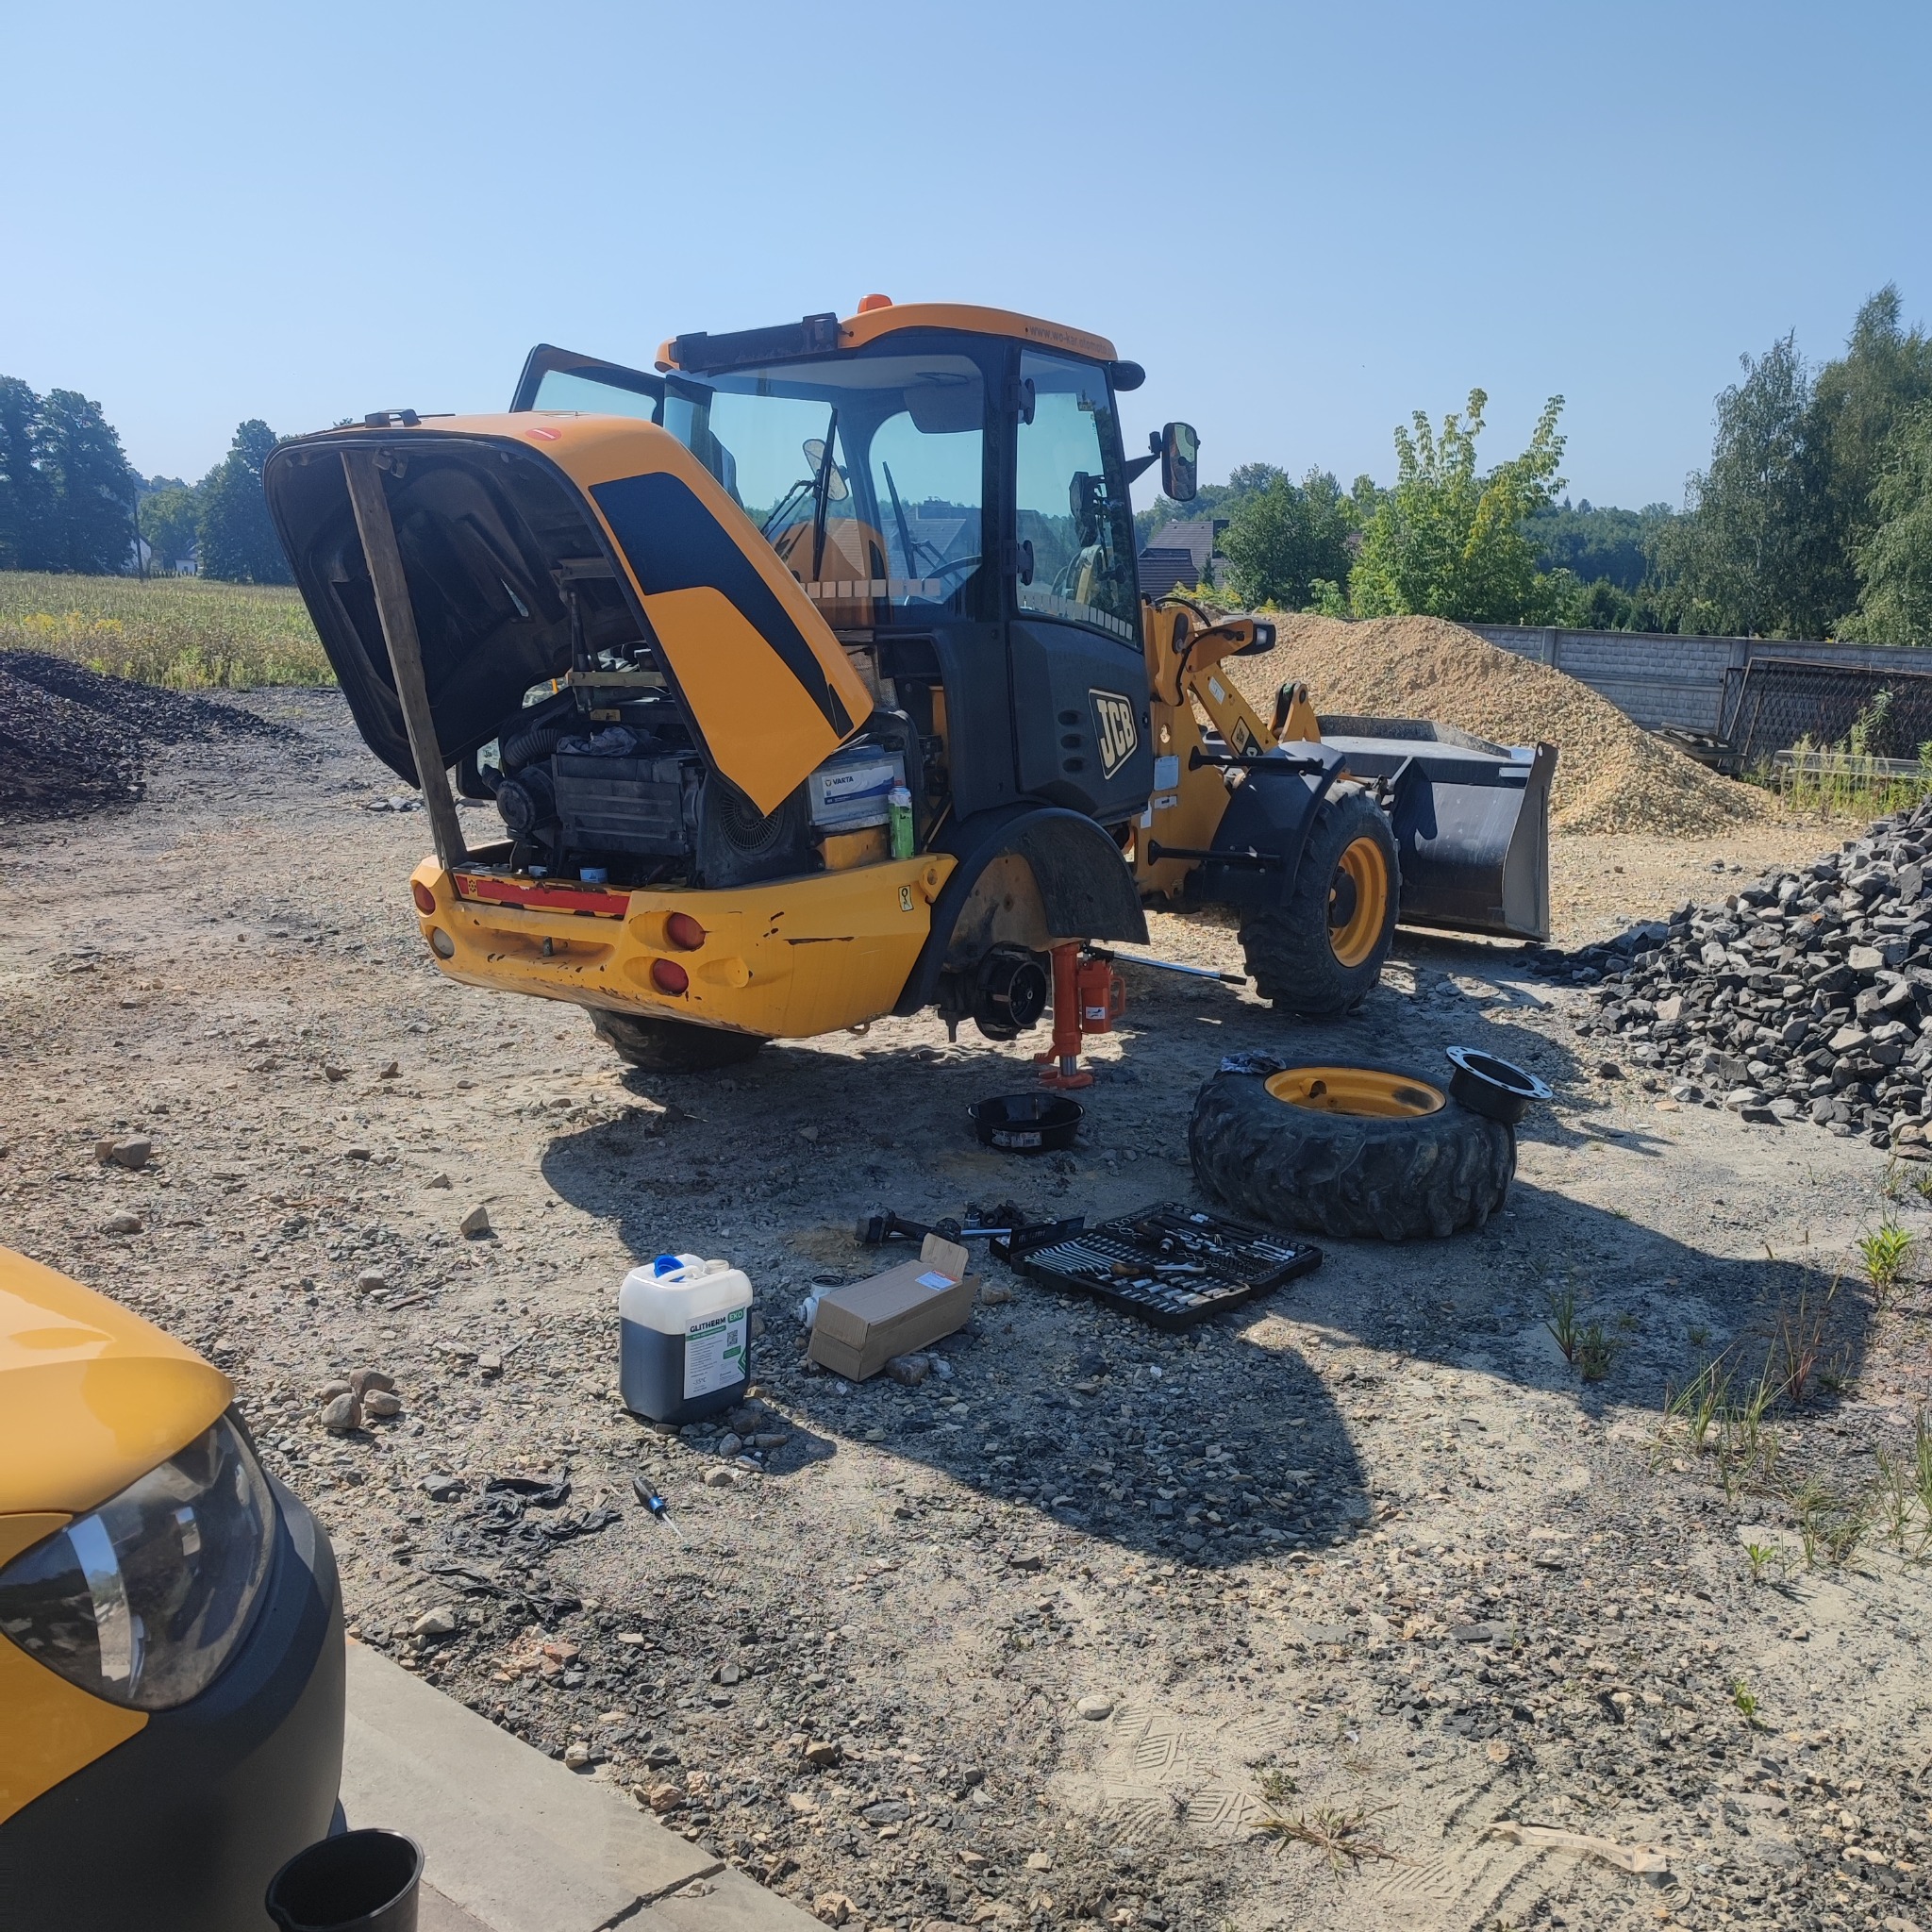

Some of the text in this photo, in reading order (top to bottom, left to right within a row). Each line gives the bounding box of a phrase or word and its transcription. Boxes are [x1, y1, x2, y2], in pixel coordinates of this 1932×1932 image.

[1096, 699, 1135, 769] JCB
[833, 776, 854, 785] VARTA
[690, 1317, 726, 1333] GLITHERM
[729, 1310, 743, 1321] EKO
